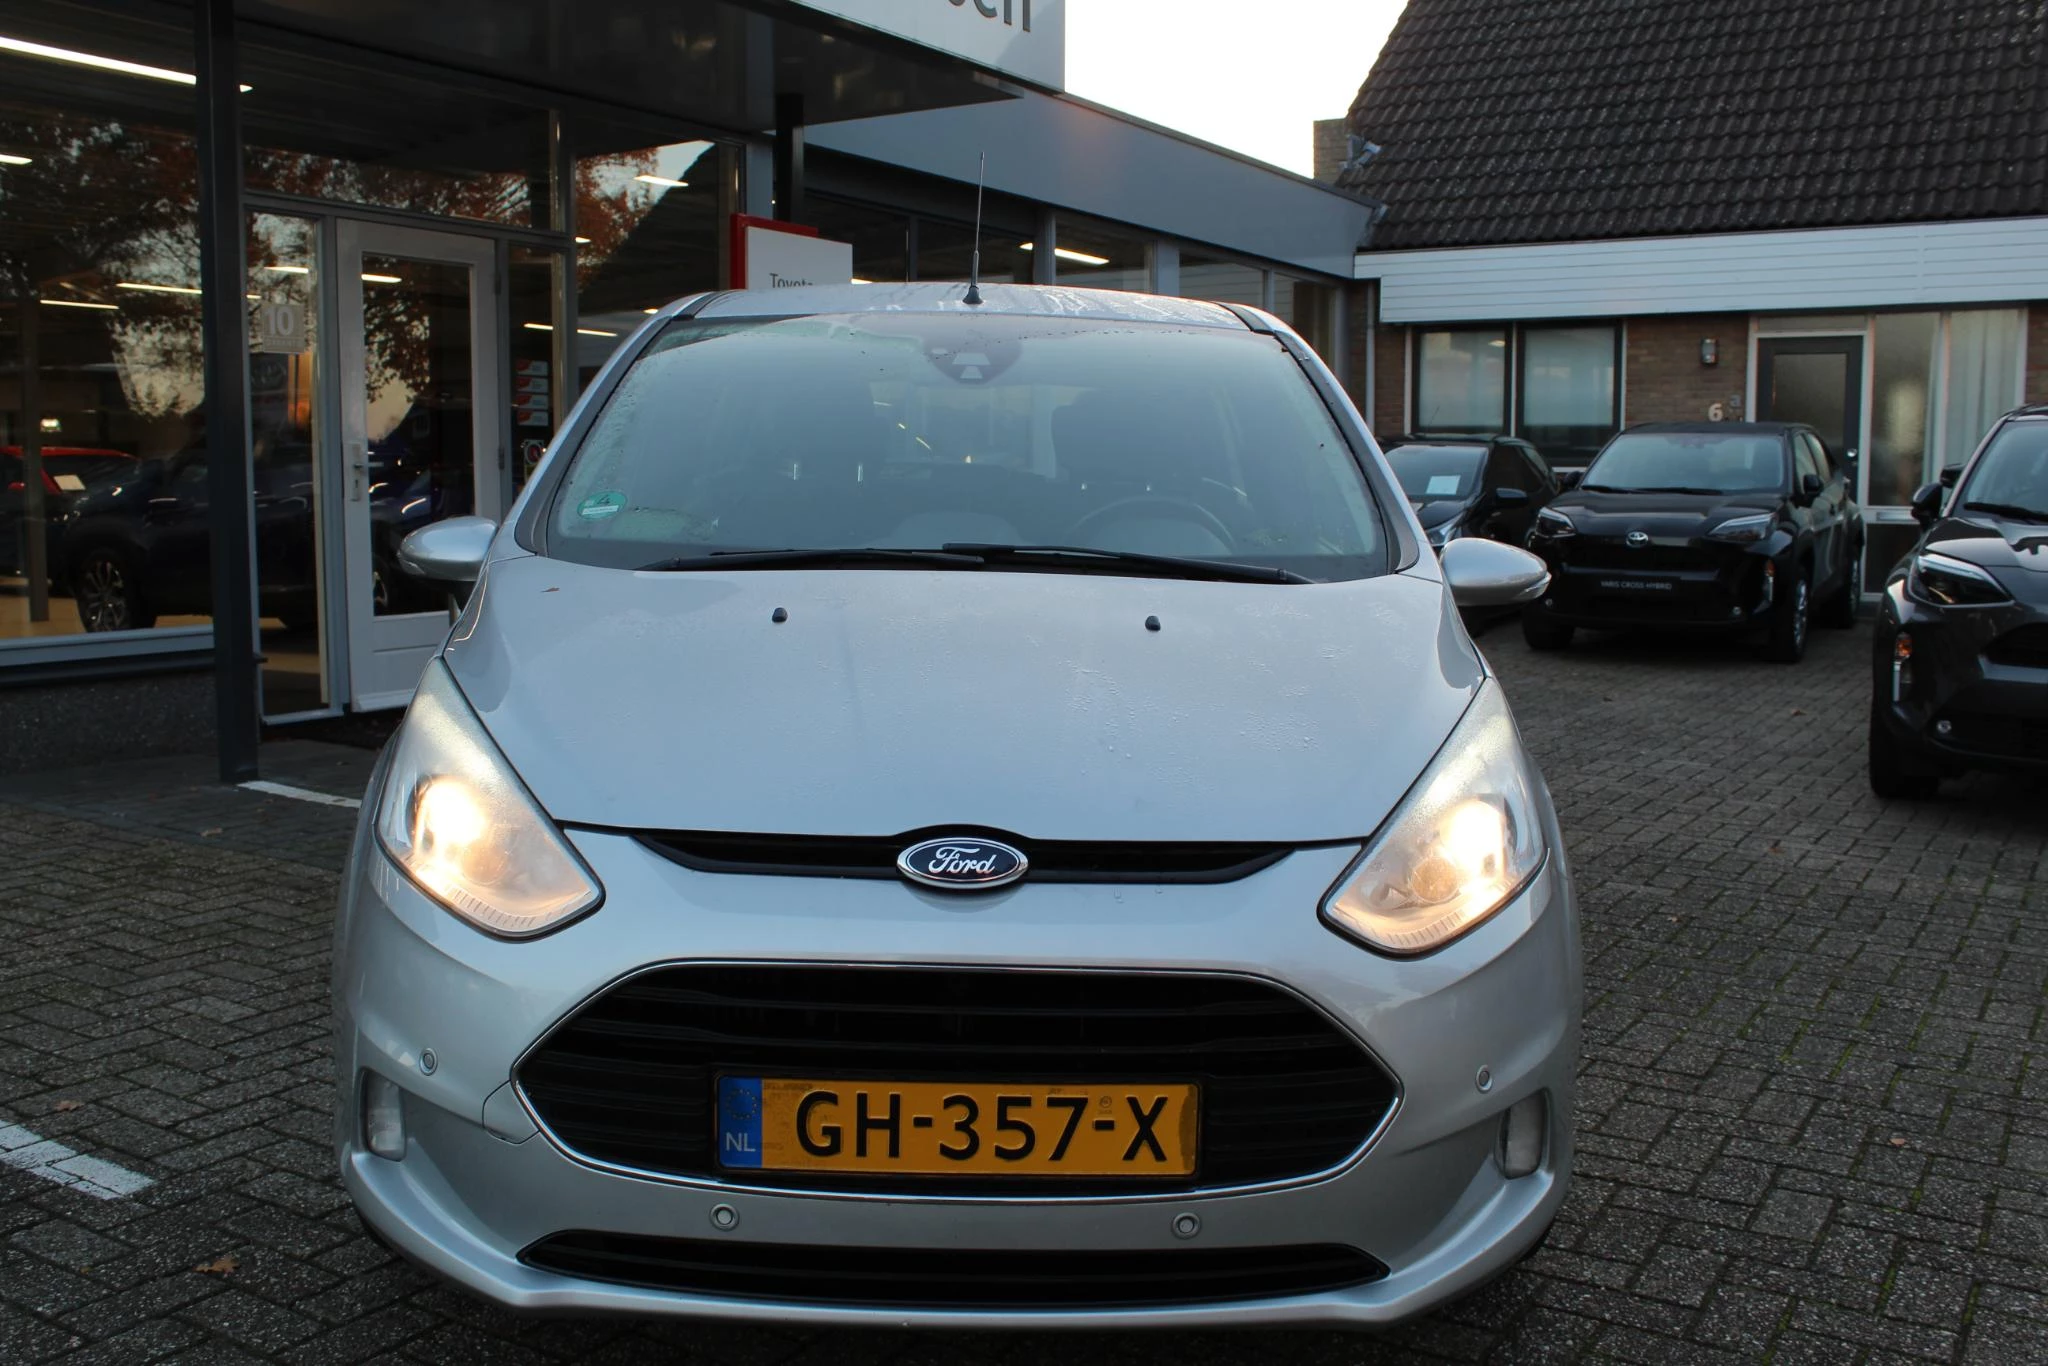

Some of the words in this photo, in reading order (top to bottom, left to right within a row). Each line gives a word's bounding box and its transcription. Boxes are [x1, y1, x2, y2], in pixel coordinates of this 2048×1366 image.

[264, 306, 294, 336] 10
[1708, 403, 1723, 422] 6
[928, 846, 997, 874] Ford
[796, 1090, 1169, 1162] GH-357-X
[725, 1131, 756, 1152] NL
